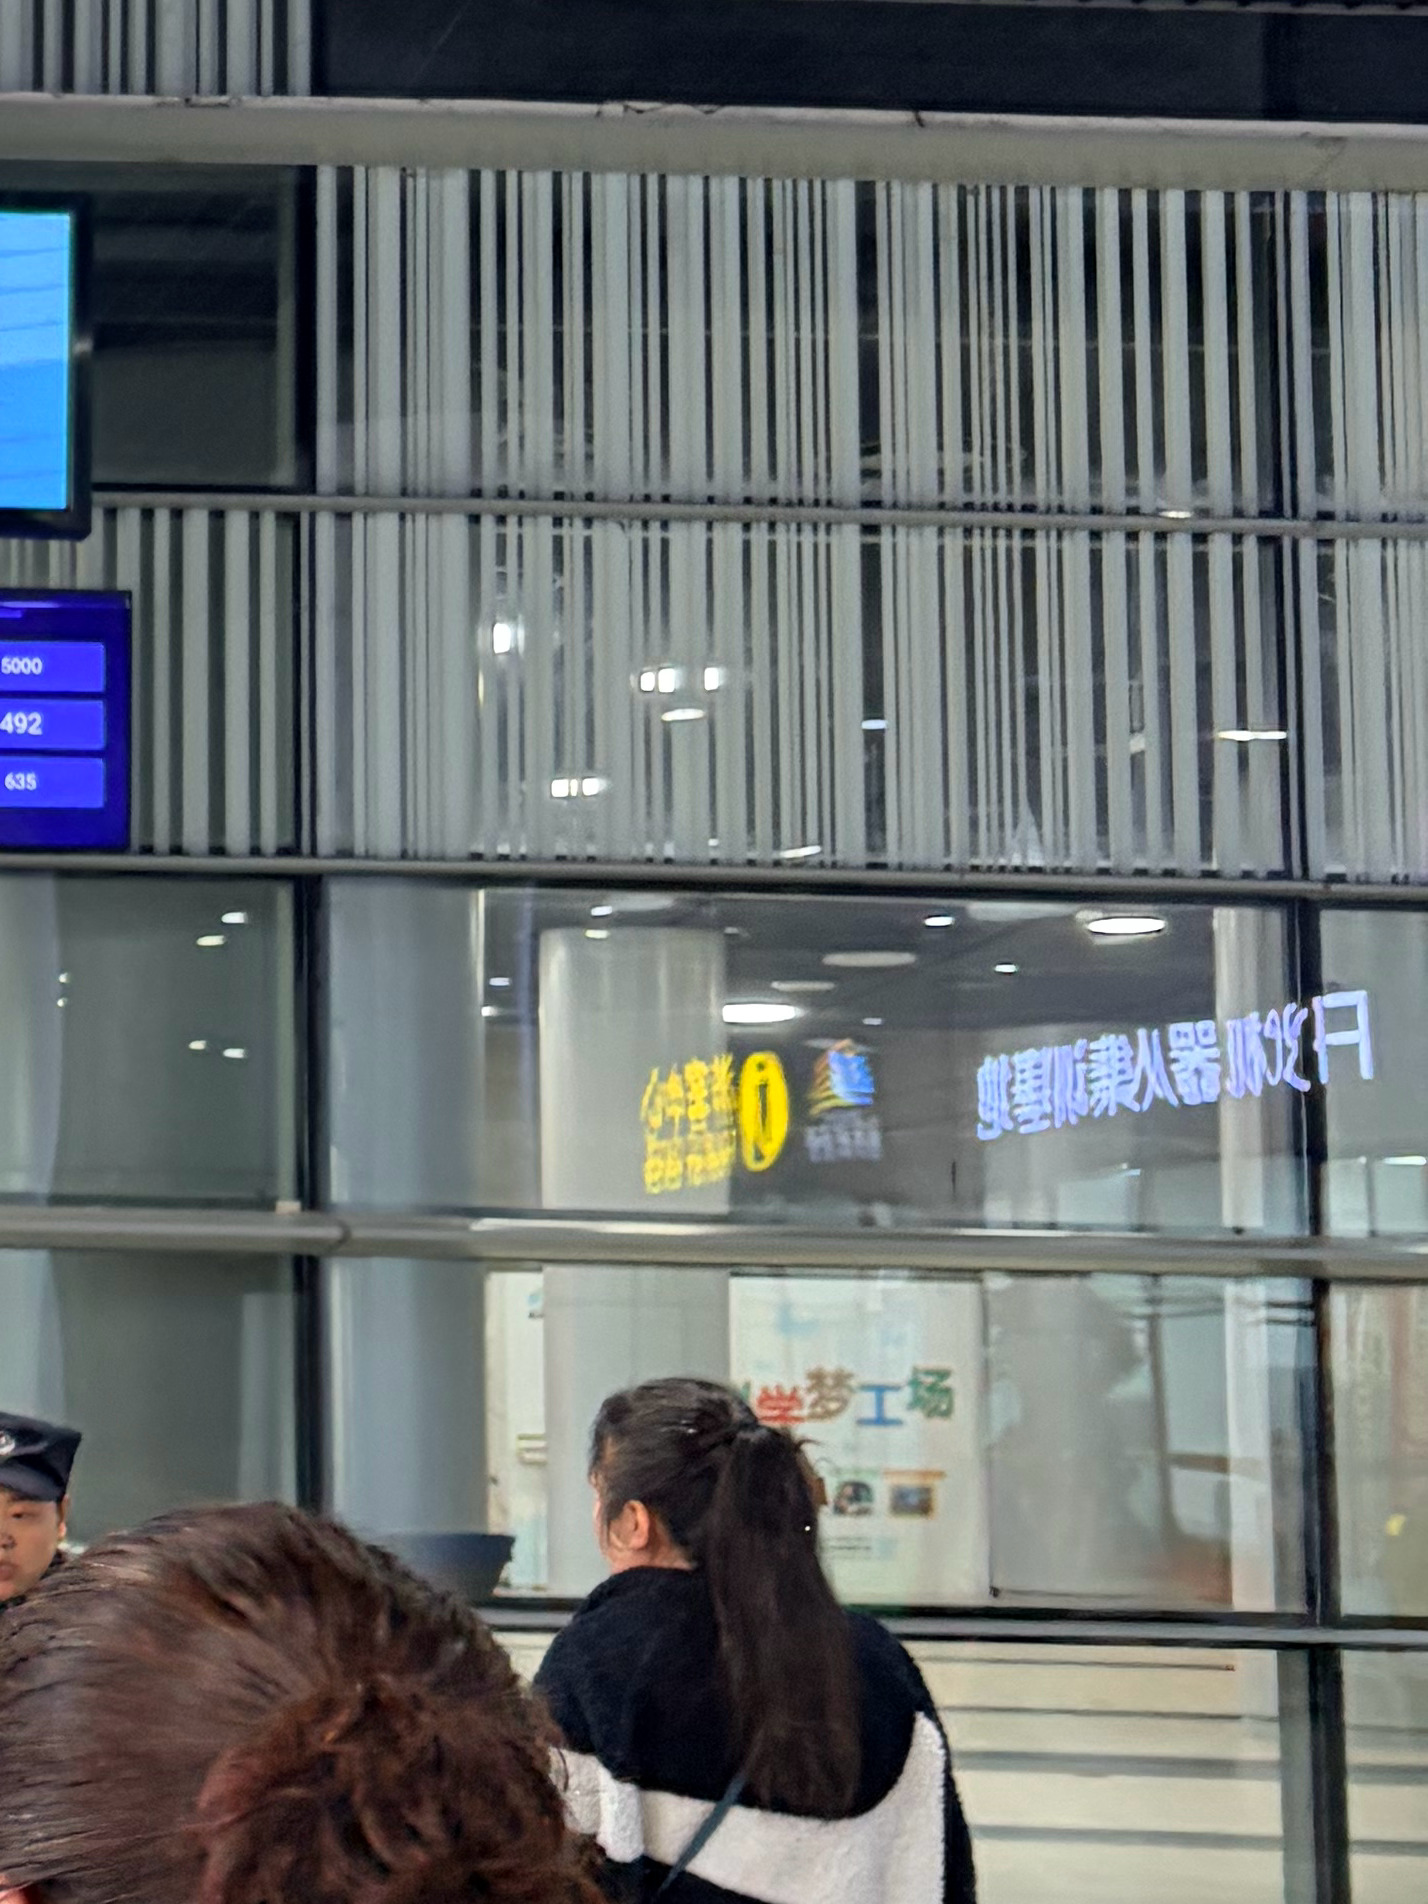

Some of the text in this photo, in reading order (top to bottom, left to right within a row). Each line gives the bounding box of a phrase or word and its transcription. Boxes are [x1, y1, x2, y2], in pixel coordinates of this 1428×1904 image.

[0, 656, 43, 675] 5000
[0, 711, 43, 736] 492
[4, 772, 37, 791] 635
[741, 1366, 955, 1427] 学梦工场
